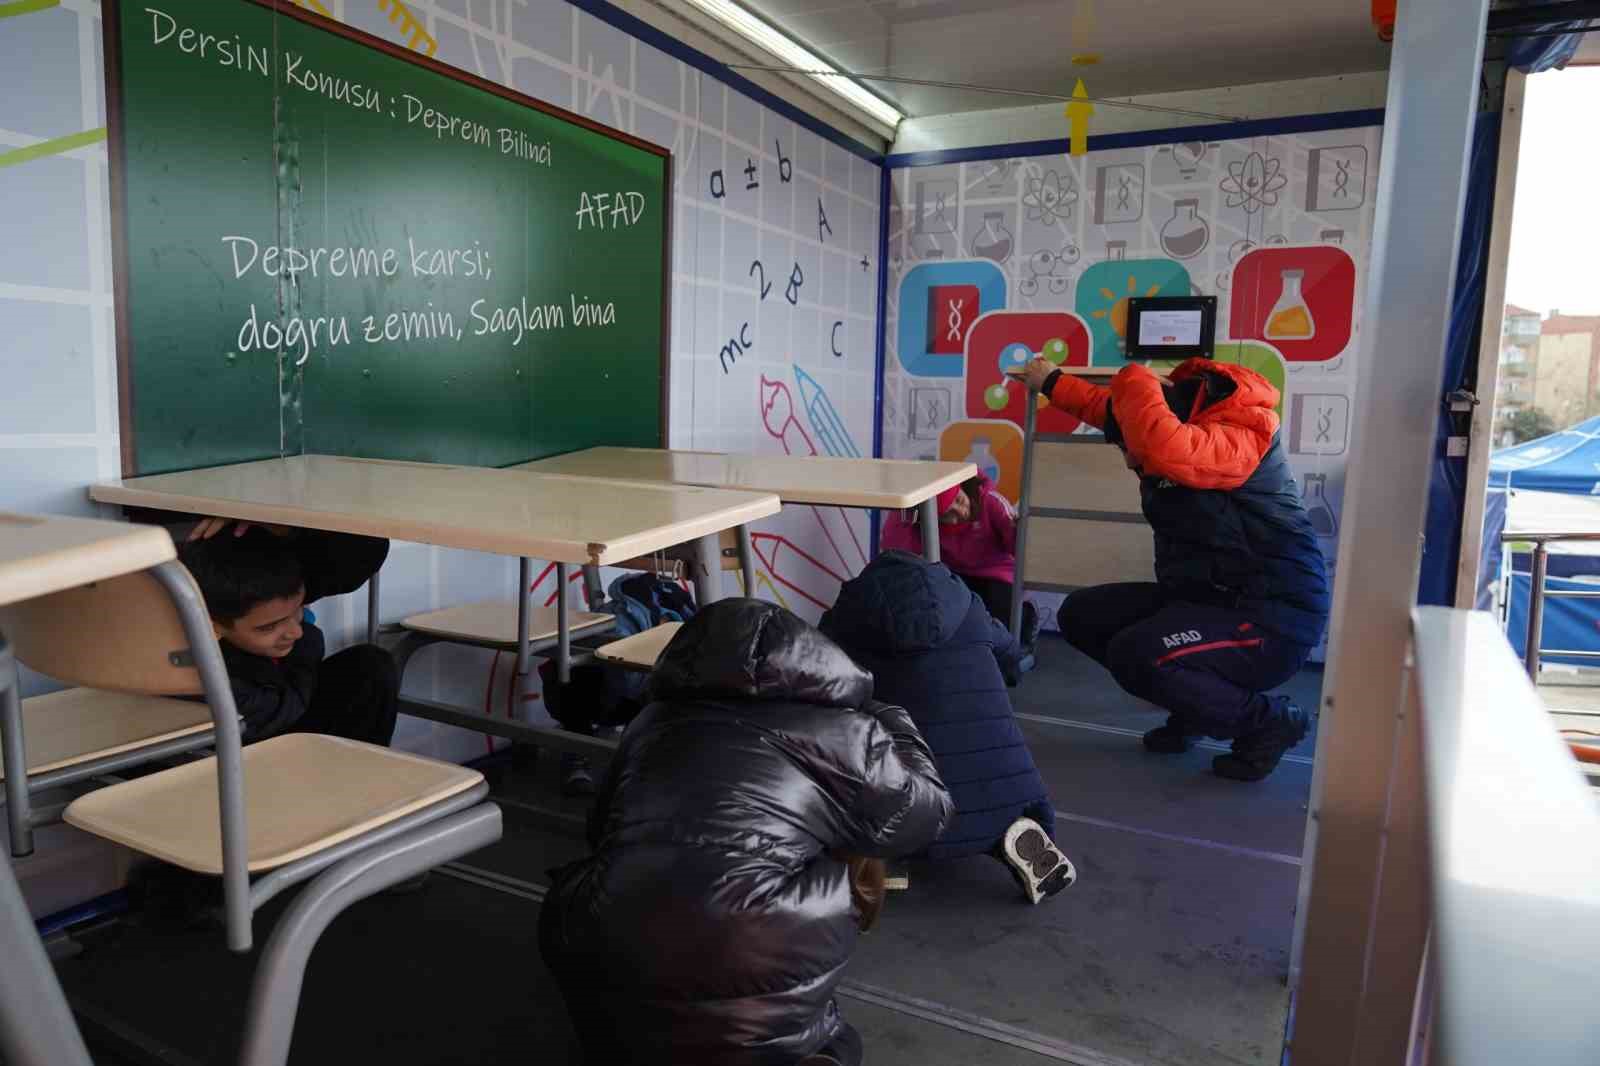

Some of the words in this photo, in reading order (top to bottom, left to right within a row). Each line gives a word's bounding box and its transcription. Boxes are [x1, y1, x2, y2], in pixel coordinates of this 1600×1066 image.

[145, 7, 268, 76] DersiN
[285, 52, 381, 113] Konusu
[402, 94, 491, 148] Deprem
[497, 128, 551, 168] Bilinci
[575, 191, 645, 230] AFAD
[817, 197, 833, 243] A
[222, 235, 399, 288] Depreme
[409, 237, 492, 280] karsi;
[238, 303, 350, 366] dogru
[361, 302, 463, 343] zemin,
[470, 296, 565, 346] Saglam
[570, 293, 616, 327] bina
[1162, 630, 1202, 648] AFAD
